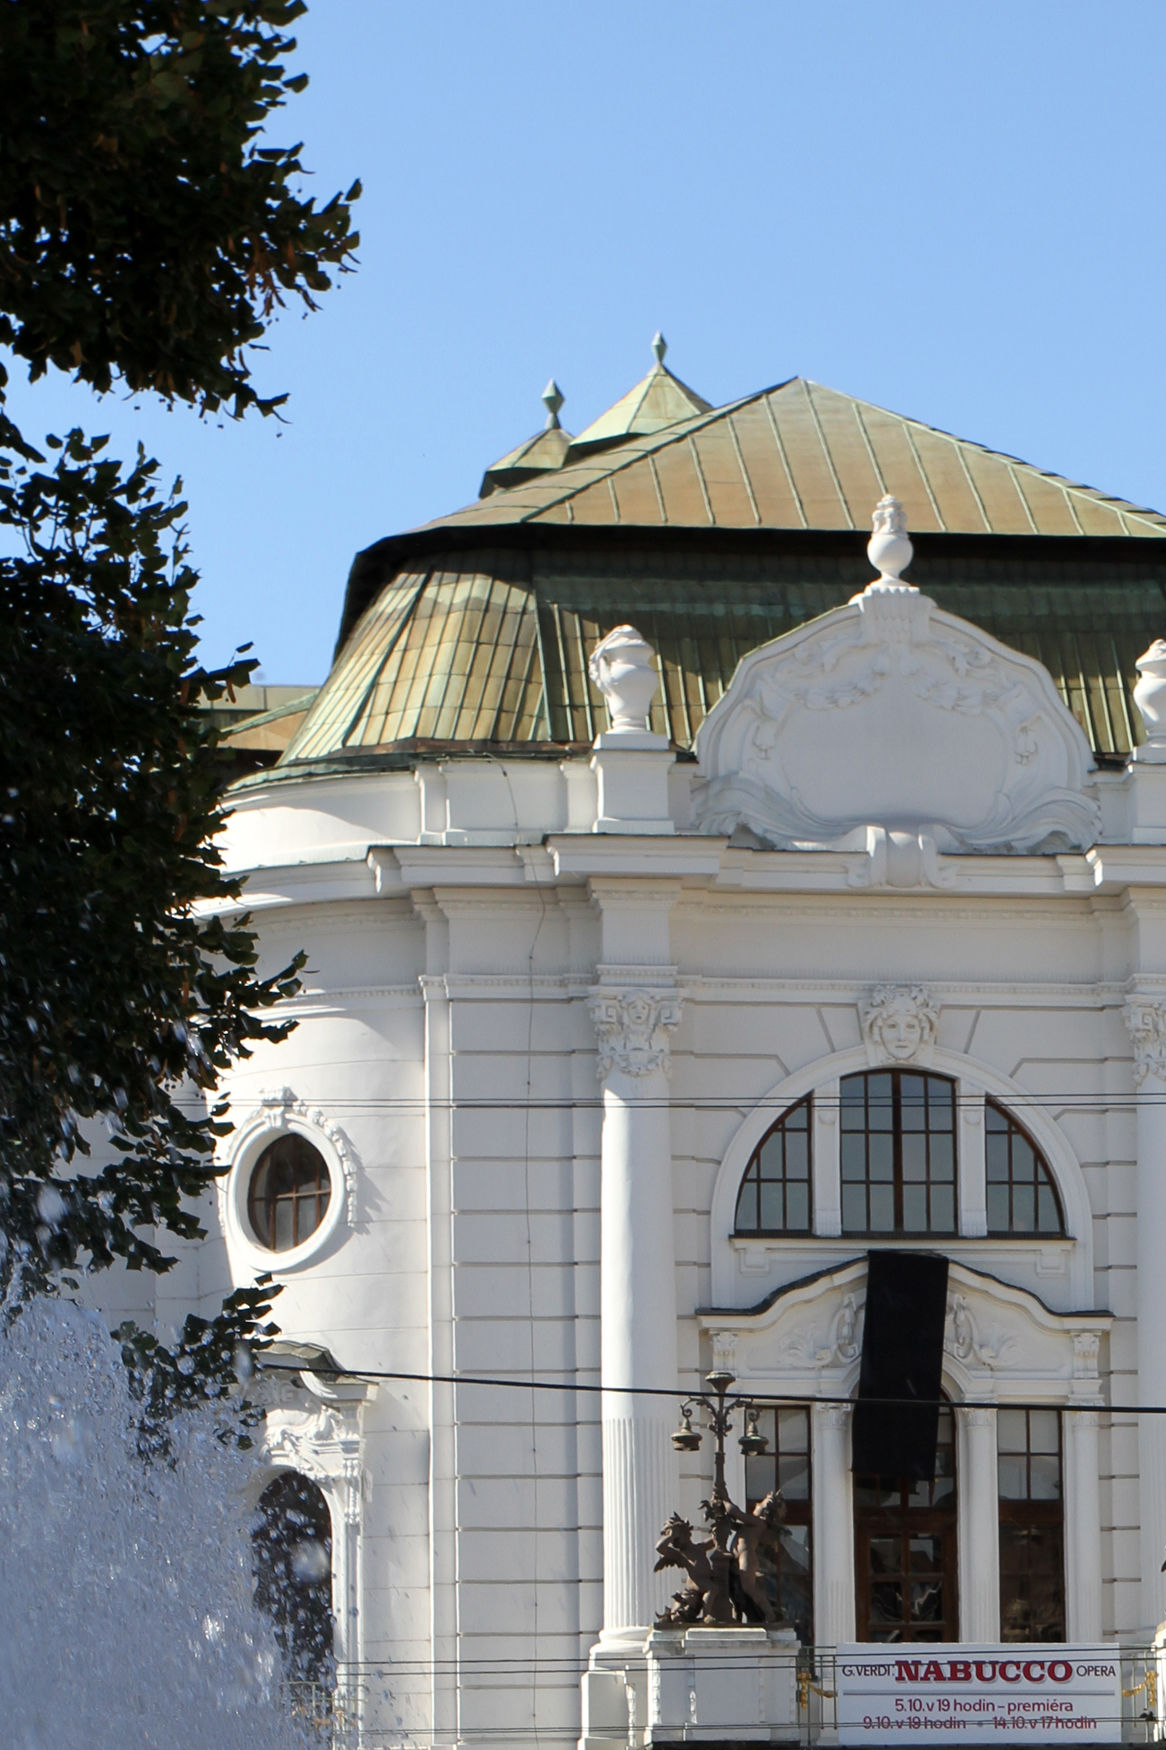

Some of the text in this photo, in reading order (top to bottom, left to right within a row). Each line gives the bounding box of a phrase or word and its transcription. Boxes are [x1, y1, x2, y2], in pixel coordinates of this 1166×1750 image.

[895, 1660, 1073, 1682] NABUCCO
[1076, 1665, 1116, 1677] OPERA
[937, 1699, 950, 1712] 19
[953, 1699, 995, 1712] hodin
[1007, 1699, 1073, 1715] premiéra
[924, 1716, 966, 1729] hodin
[1041, 1716, 1053, 1729] 17
[1055, 1716, 1097, 1729] hodin
